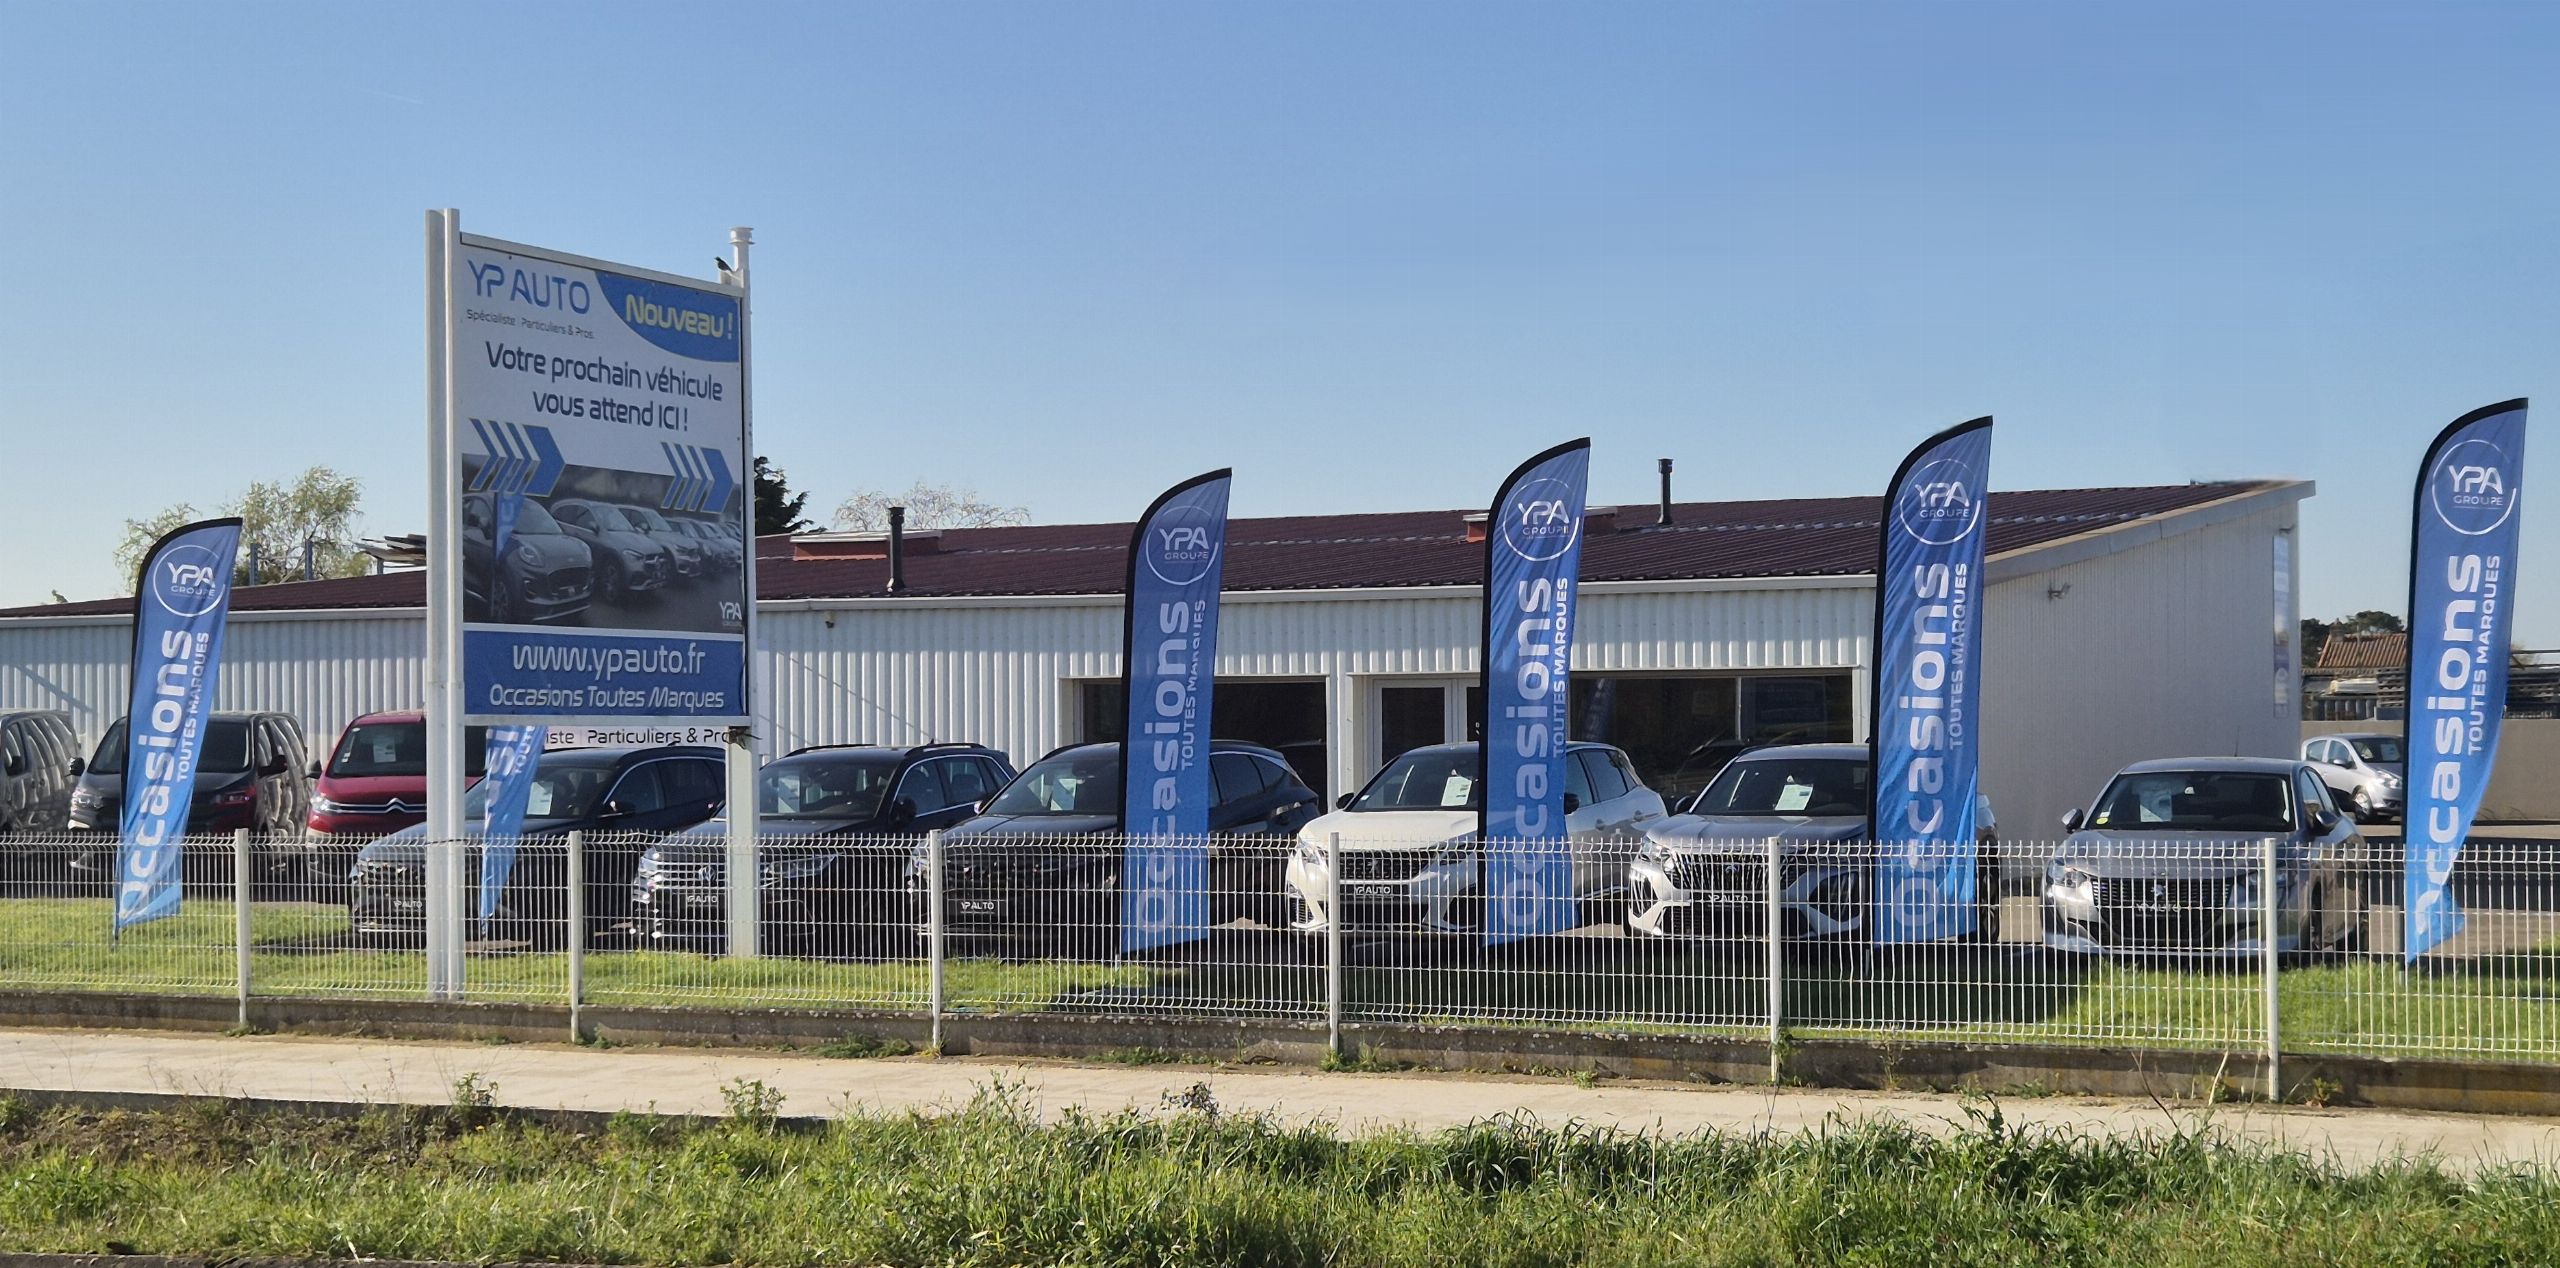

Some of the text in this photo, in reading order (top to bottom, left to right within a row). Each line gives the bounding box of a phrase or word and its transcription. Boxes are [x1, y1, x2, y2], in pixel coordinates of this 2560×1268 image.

[467, 260, 591, 314] YP AUTO
[466, 309, 516, 326] Spécialiste
[521, 317, 566, 335] Particuliers
[567, 324, 574, 336] &
[626, 294, 724, 338] Nouveau
[485, 340, 723, 401] Votre prochain véhicule
[533, 391, 584, 417] vous
[590, 399, 654, 428] attend
[658, 404, 680, 431] ICI
[1915, 482, 1970, 507] YPA
[2448, 465, 2503, 494] YPA
[1518, 500, 1570, 525] YPA
[2454, 495, 2503, 505] GROUPE
[1159, 527, 1209, 550] YPA
[167, 562, 216, 588] YPA
[171, 585, 216, 597] GROUE
[720, 601, 742, 620] YPA
[512, 642, 706, 680] www.ypauto.fr
[1552, 578, 1568, 757] TOUTES MARQUES
[1949, 563, 1967, 750] TOUTES MARQUES
[2467, 555, 2500, 756] TOUTES MARQUES
[177, 632, 210, 782] TOUTES MARQUES
[489, 683, 725, 713] Occasions Toutes Marques
[587, 728, 681, 744] Particuliers
[686, 728, 698, 744] &
[1181, 695, 1197, 770] TOUTES
